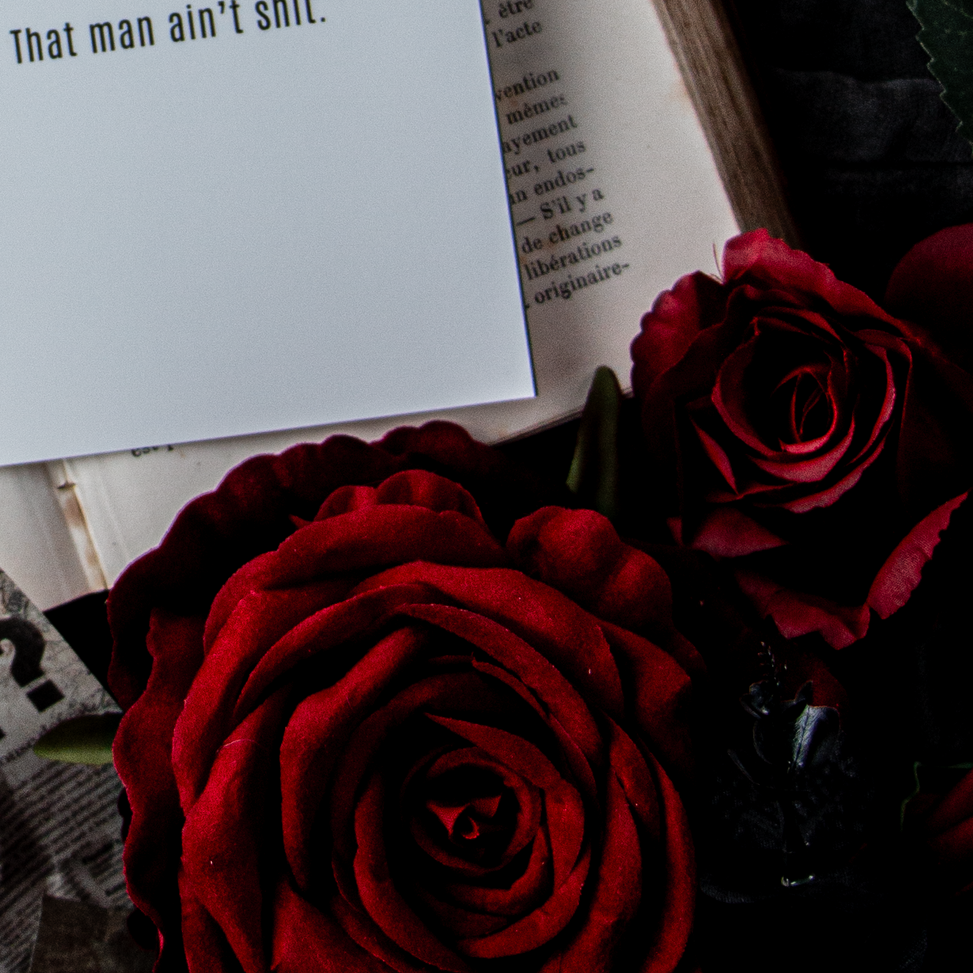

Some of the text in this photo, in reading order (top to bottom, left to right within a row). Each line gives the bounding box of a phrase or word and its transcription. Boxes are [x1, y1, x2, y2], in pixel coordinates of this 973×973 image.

[10, 21, 77, 64] That
[89, 15, 155, 54] man
[547, 140, 586, 165] tous
[534, 167, 595, 196] endos-
[521, 211, 615, 256] de change
[524, 235, 623, 281] libérations
[534, 263, 631, 306] originaire-
